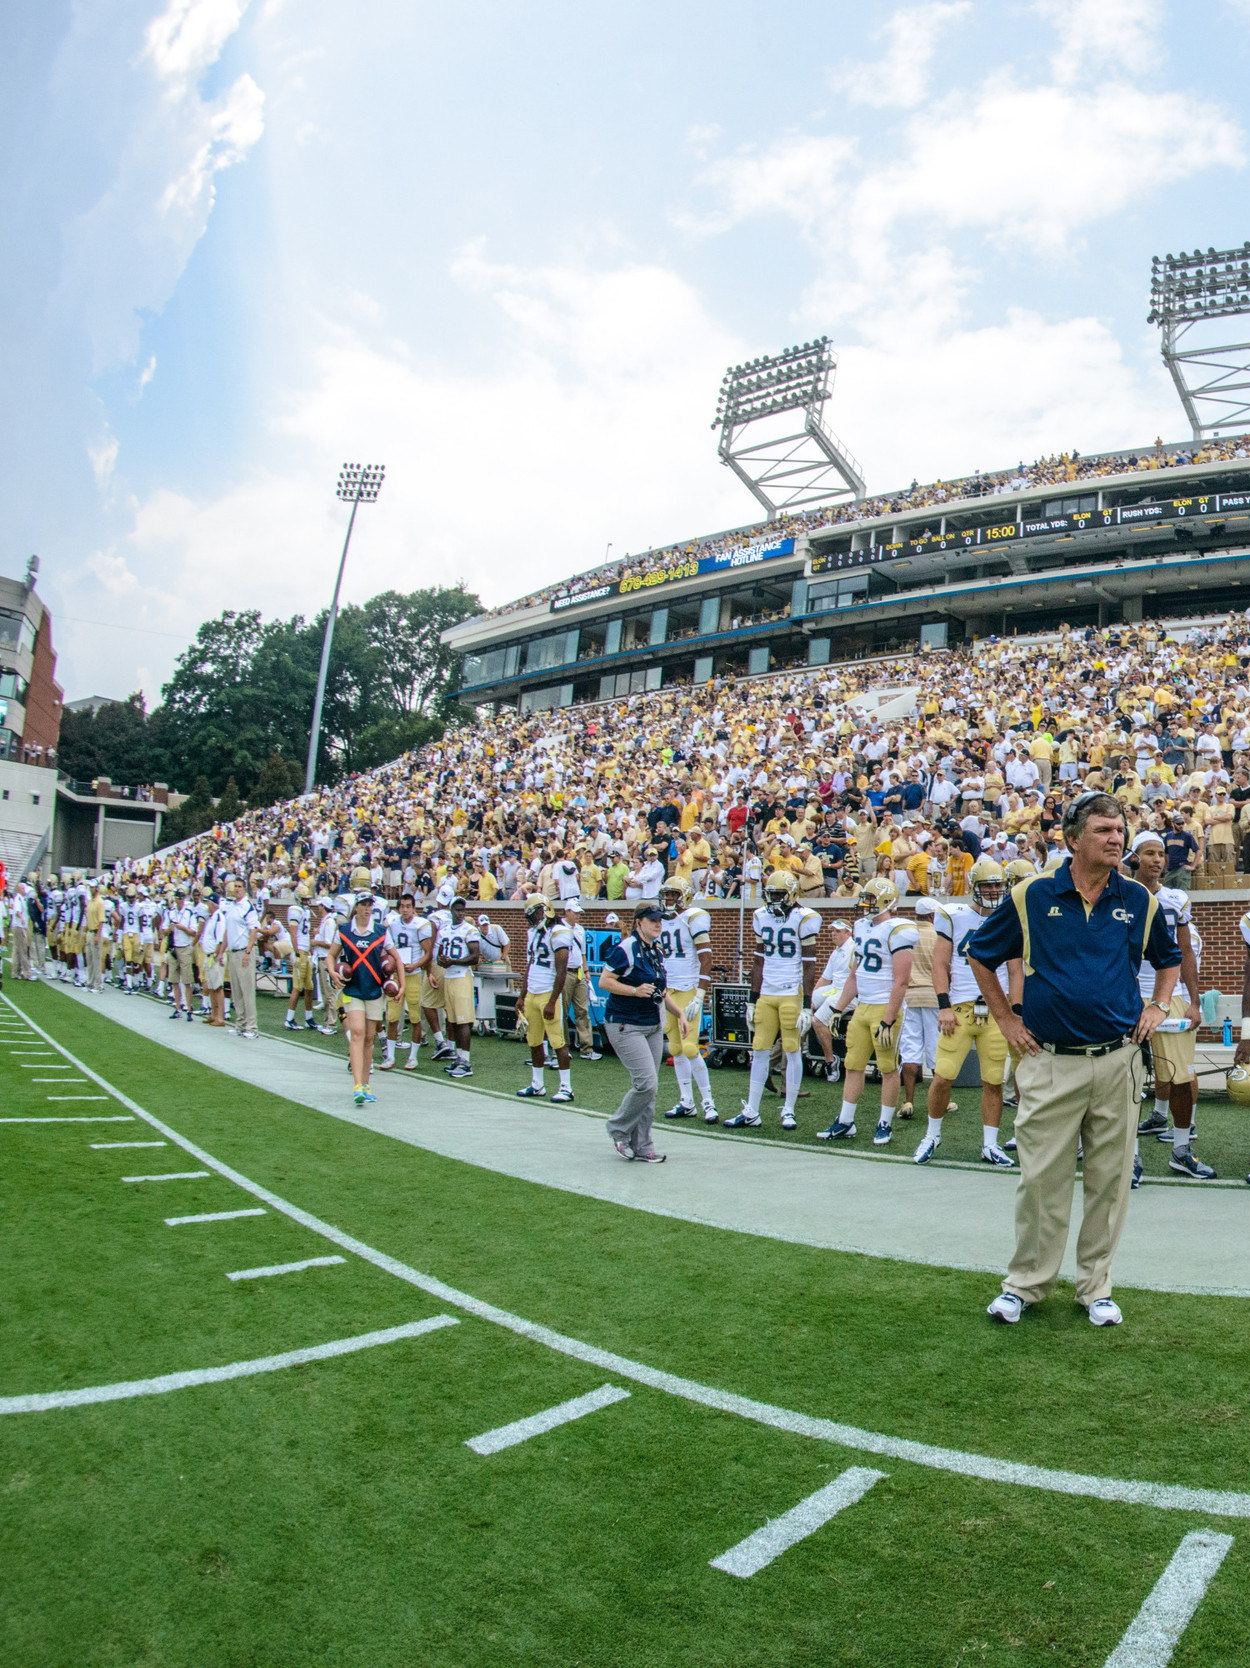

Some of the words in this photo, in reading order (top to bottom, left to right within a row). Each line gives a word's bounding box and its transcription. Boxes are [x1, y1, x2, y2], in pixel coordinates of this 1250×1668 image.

[1172, 498, 1192, 507] ELON
[1198, 496, 1209, 504] GT
[1222, 497, 1245, 506] PASS
[1122, 510, 1144, 519] RUSH
[1144, 506, 1162, 516] YDS:
[1178, 506, 1186, 516] 0
[1200, 504, 1208, 513] 0
[1073, 512, 1092, 520] ELON
[1104, 516, 1111, 525] 0
[1026, 522, 1049, 532] TOTAL
[1050, 520, 1068, 529] YDS:
[1078, 520, 1086, 529] 0
[961, 530, 975, 538] QTR
[986, 526, 1016, 540] 15:00
[931, 534, 946, 543] BALL
[965, 536, 972, 546] 0
[886, 542, 904, 551] DOWN
[916, 544, 922, 554] 0
[940, 541, 946, 550] 0
[715, 551, 732, 563] FAN
[732, 540, 782, 558] ASSISTANCE
[891, 549, 898, 558] 0
[730, 554, 764, 567] HOTLINE
[554, 597, 570, 609] NEED
[570, 586, 610, 605] ASSISTANCE?
[874, 880, 895, 894] GT
[1112, 908, 1134, 924] GT
[356, 940, 370, 948] ACC
